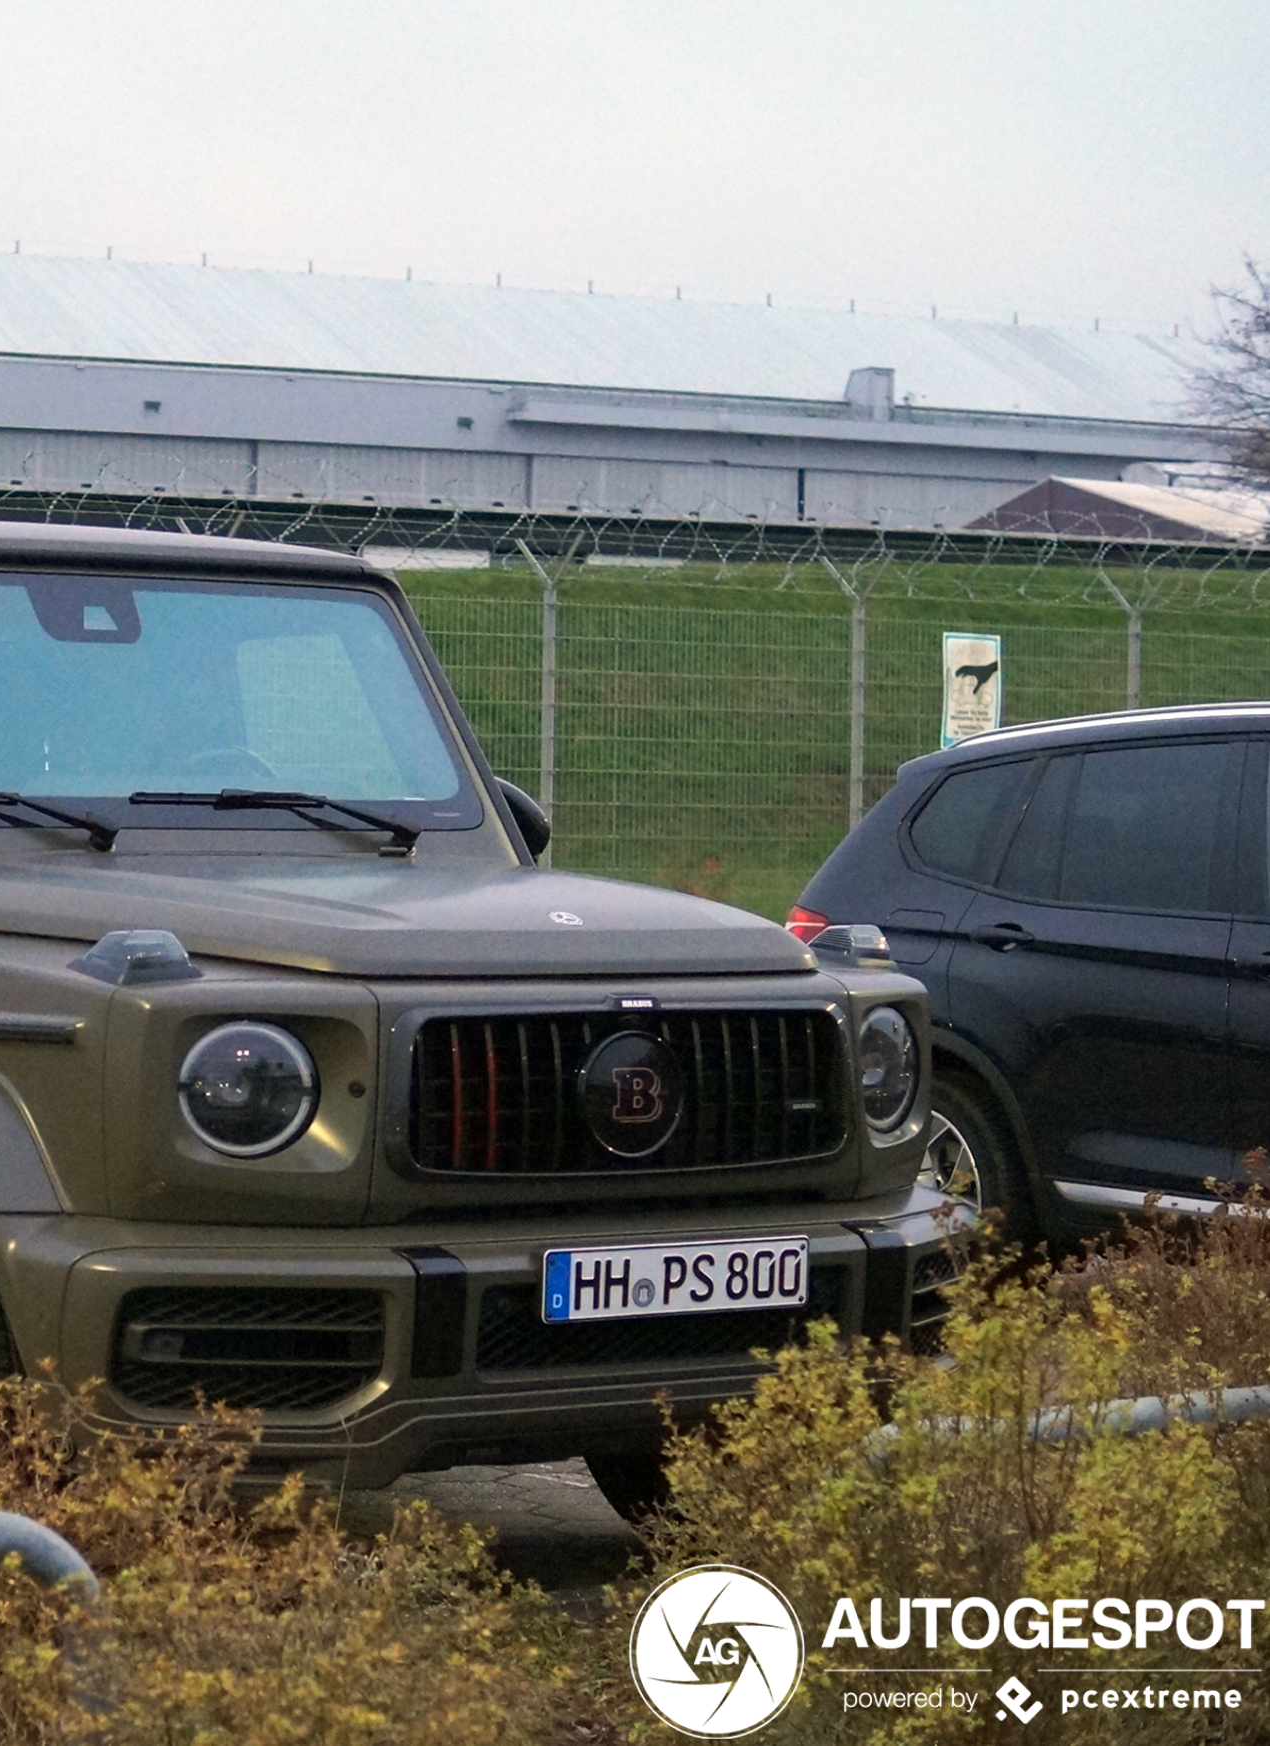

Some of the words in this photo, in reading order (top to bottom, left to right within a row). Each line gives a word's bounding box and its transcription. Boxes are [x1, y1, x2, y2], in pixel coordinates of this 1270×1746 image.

[612, 1067, 662, 1123] B
[552, 1293, 563, 1309] D
[574, 1258, 631, 1310] HH
[663, 1254, 715, 1305] PS
[726, 1249, 801, 1300] 800
